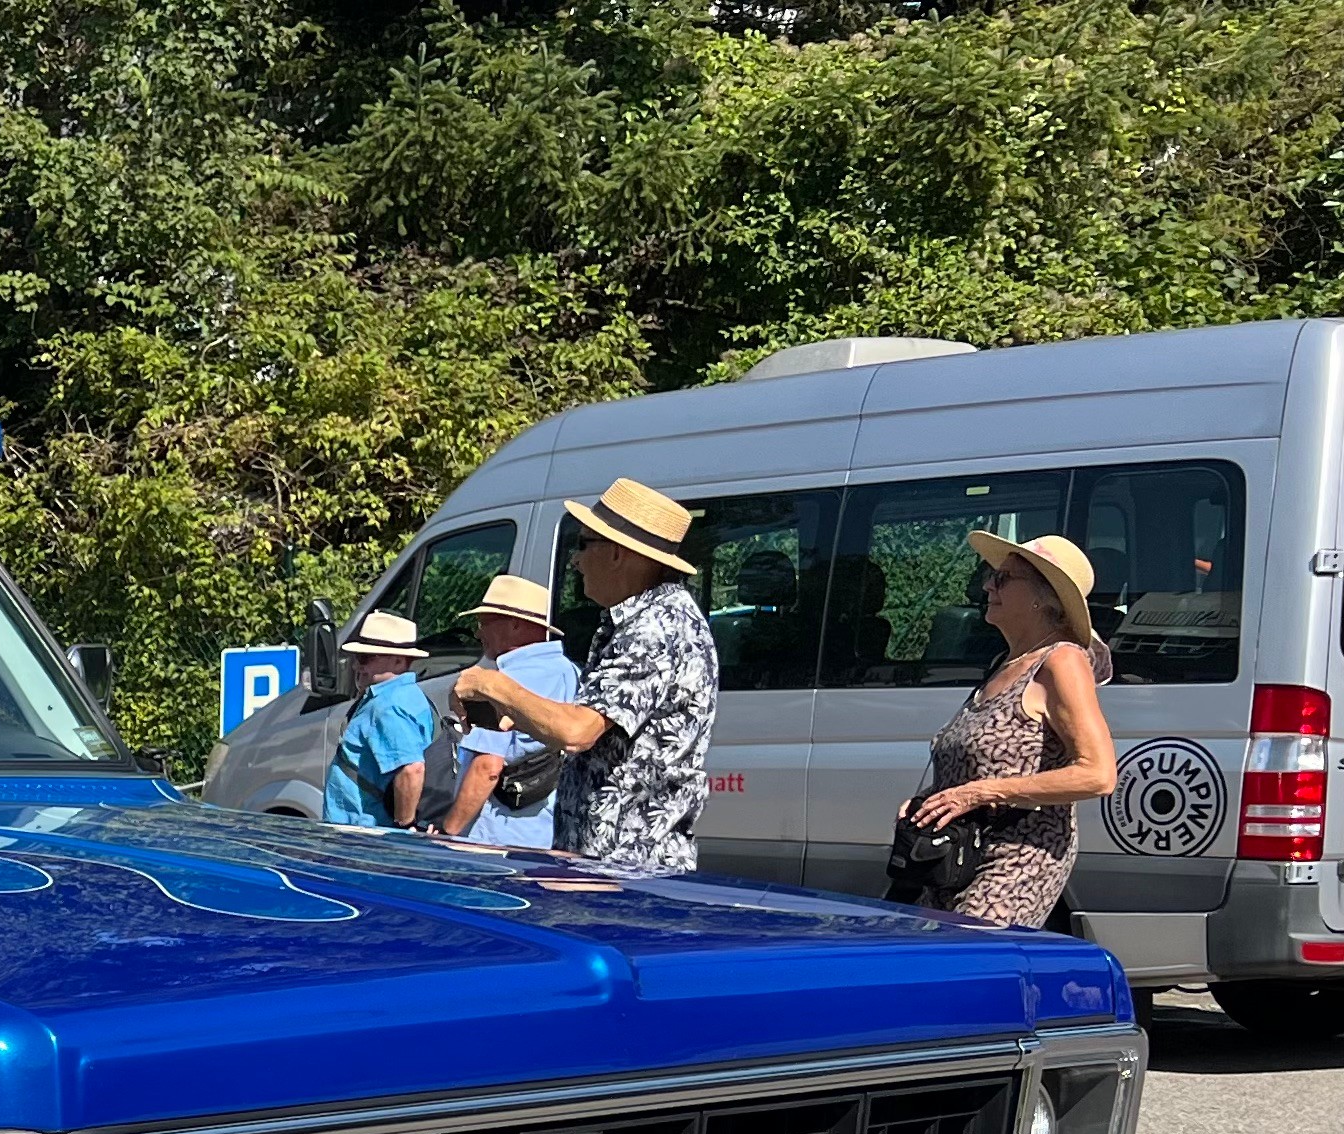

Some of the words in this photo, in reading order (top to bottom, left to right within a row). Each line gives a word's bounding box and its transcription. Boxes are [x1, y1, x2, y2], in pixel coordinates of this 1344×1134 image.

[243, 664, 280, 721] P
[709, 773, 745, 793] att
[1114, 769, 1132, 828] RESTAURANT
[1127, 752, 1214, 852] PUMPWERK
